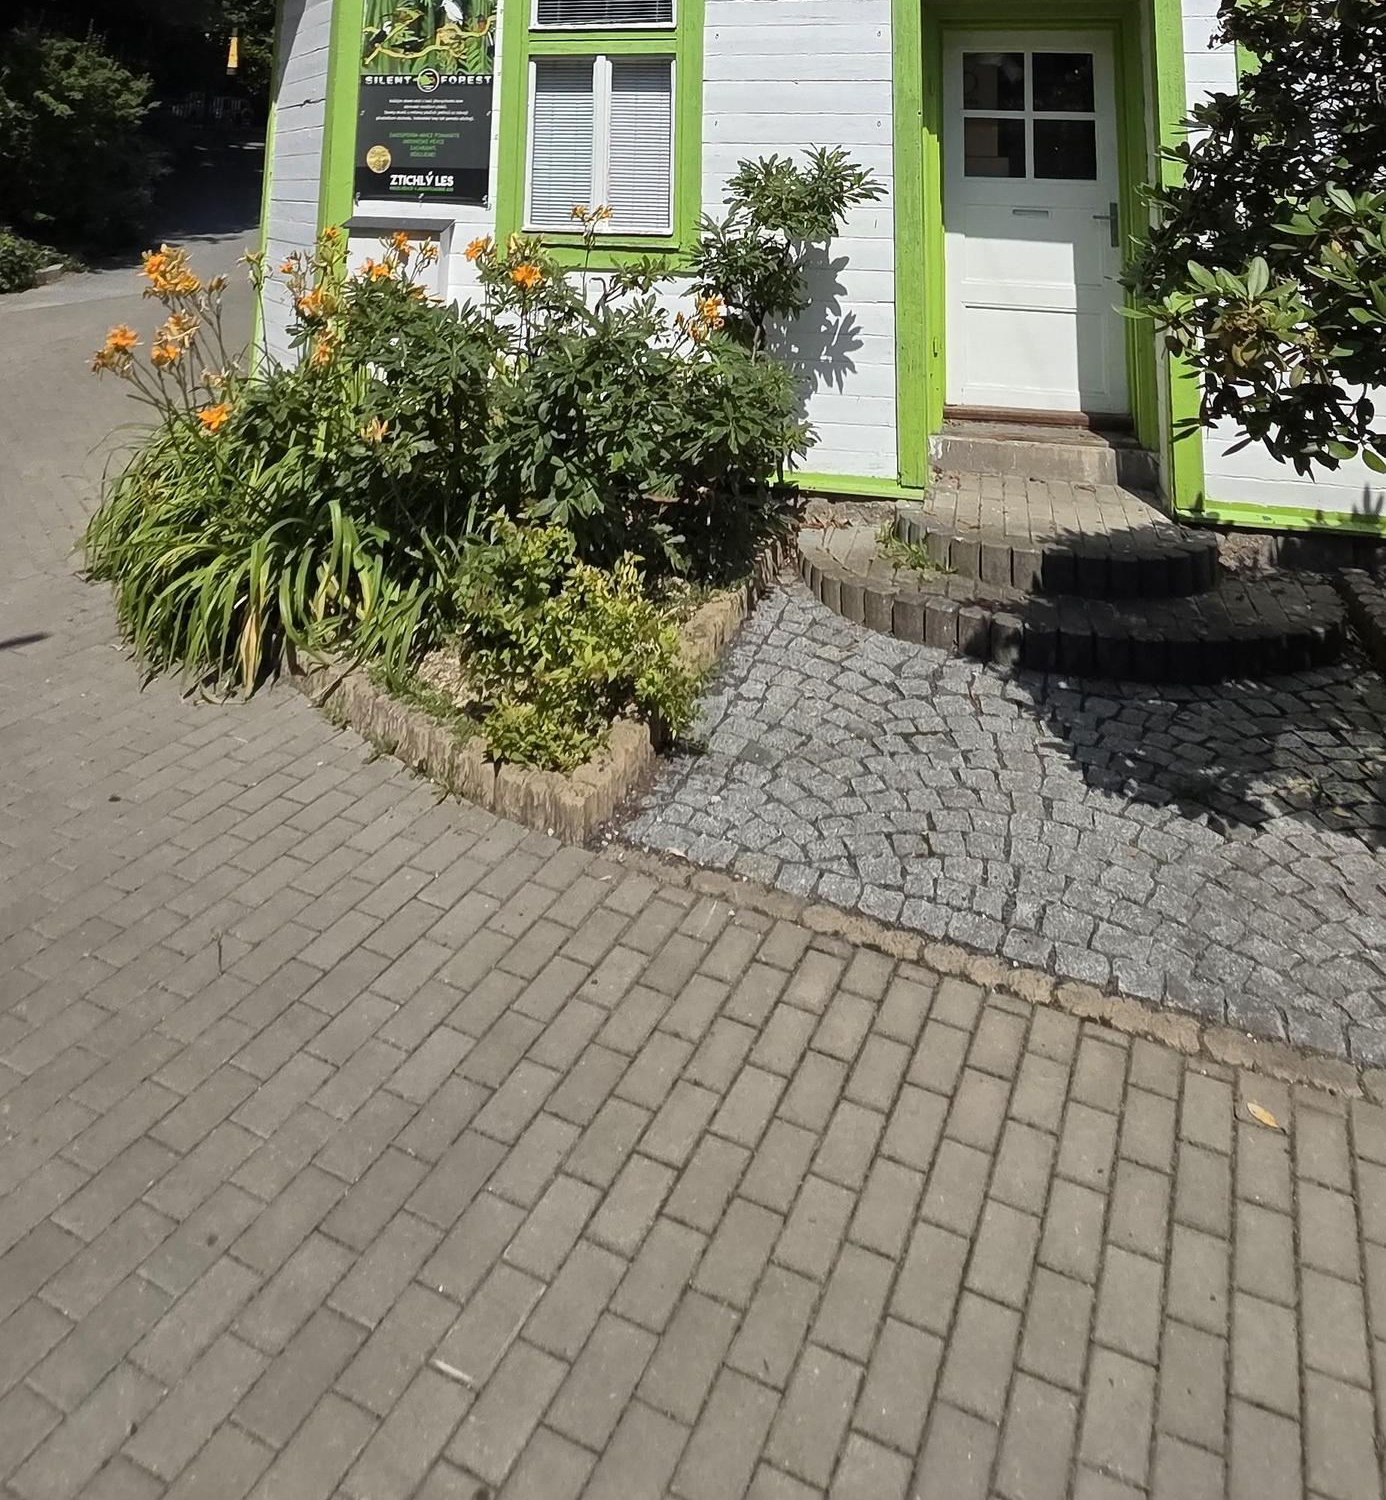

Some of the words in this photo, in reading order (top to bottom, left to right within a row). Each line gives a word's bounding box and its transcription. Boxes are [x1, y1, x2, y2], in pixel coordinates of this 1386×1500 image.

[364, 75, 412, 85] SILENT
[440, 75, 492, 85] FOREST
[389, 170, 434, 186] ZTICHLÝ
[435, 175, 455, 187] LES
